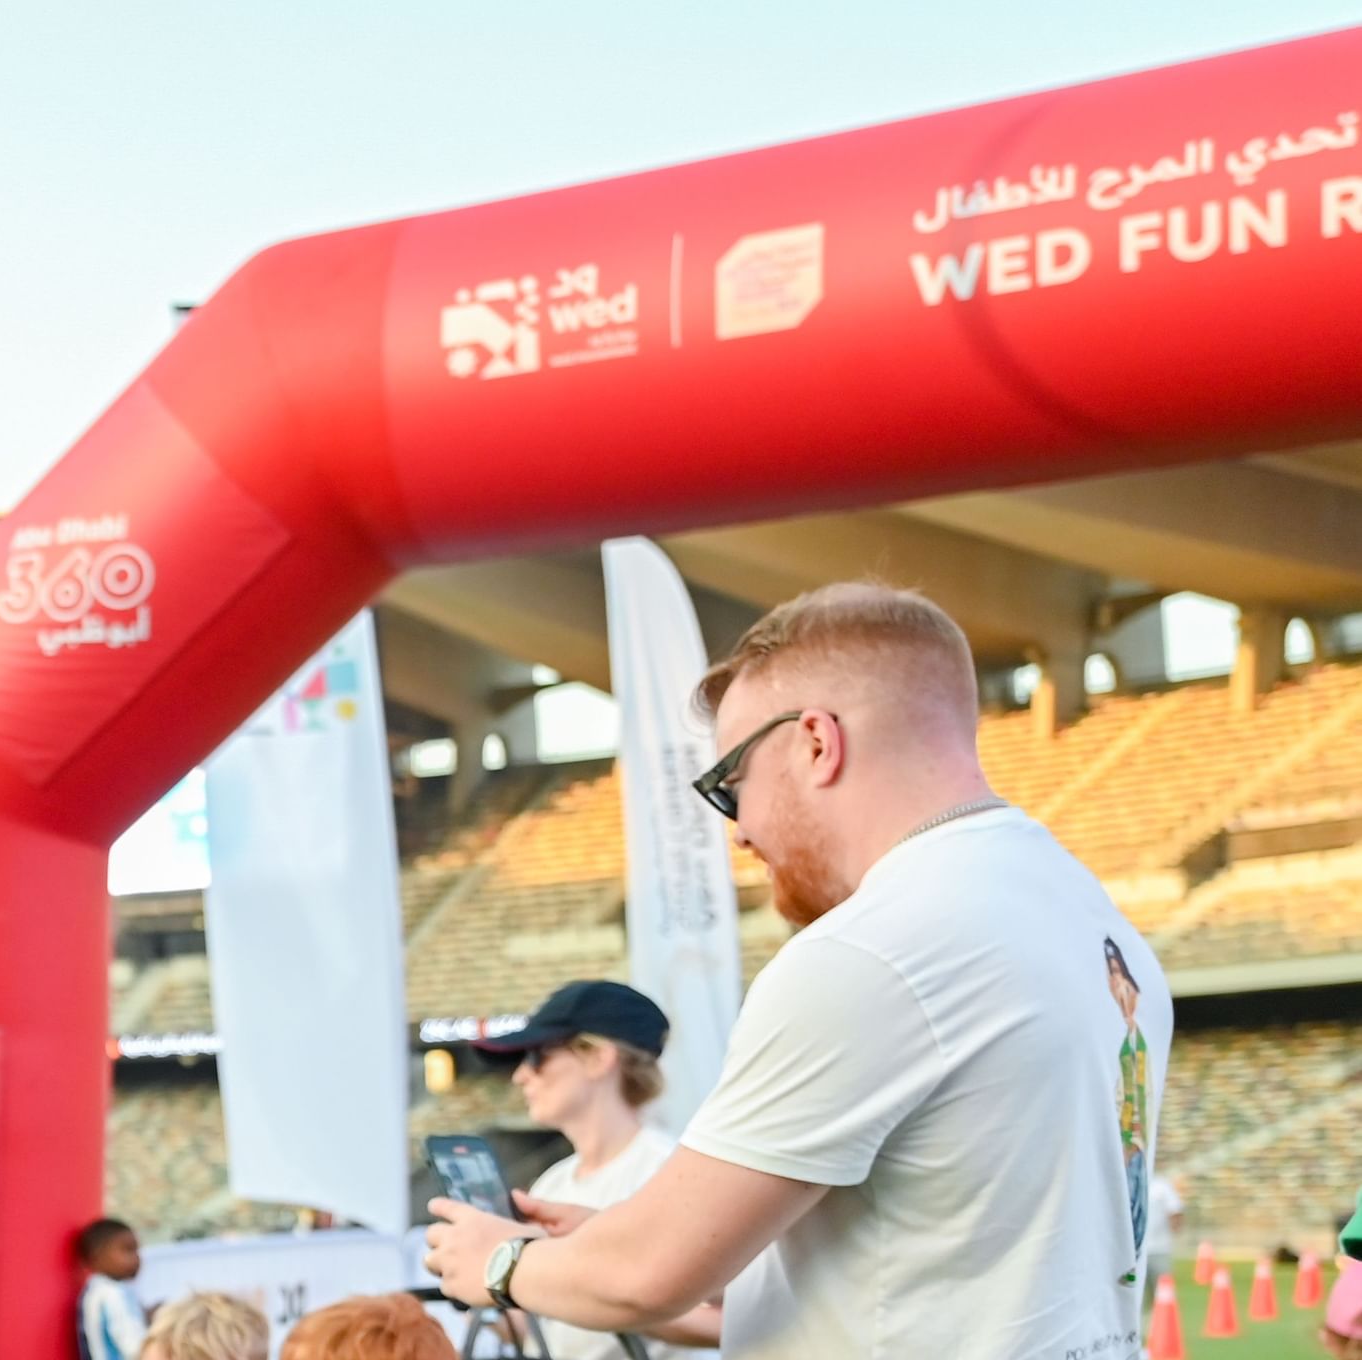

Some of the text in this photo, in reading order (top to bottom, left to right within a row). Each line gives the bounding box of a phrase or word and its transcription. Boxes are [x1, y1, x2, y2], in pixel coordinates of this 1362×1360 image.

[909, 226, 1091, 307] WED
[1119, 188, 1288, 274] FUN
[548, 282, 639, 334] wed
